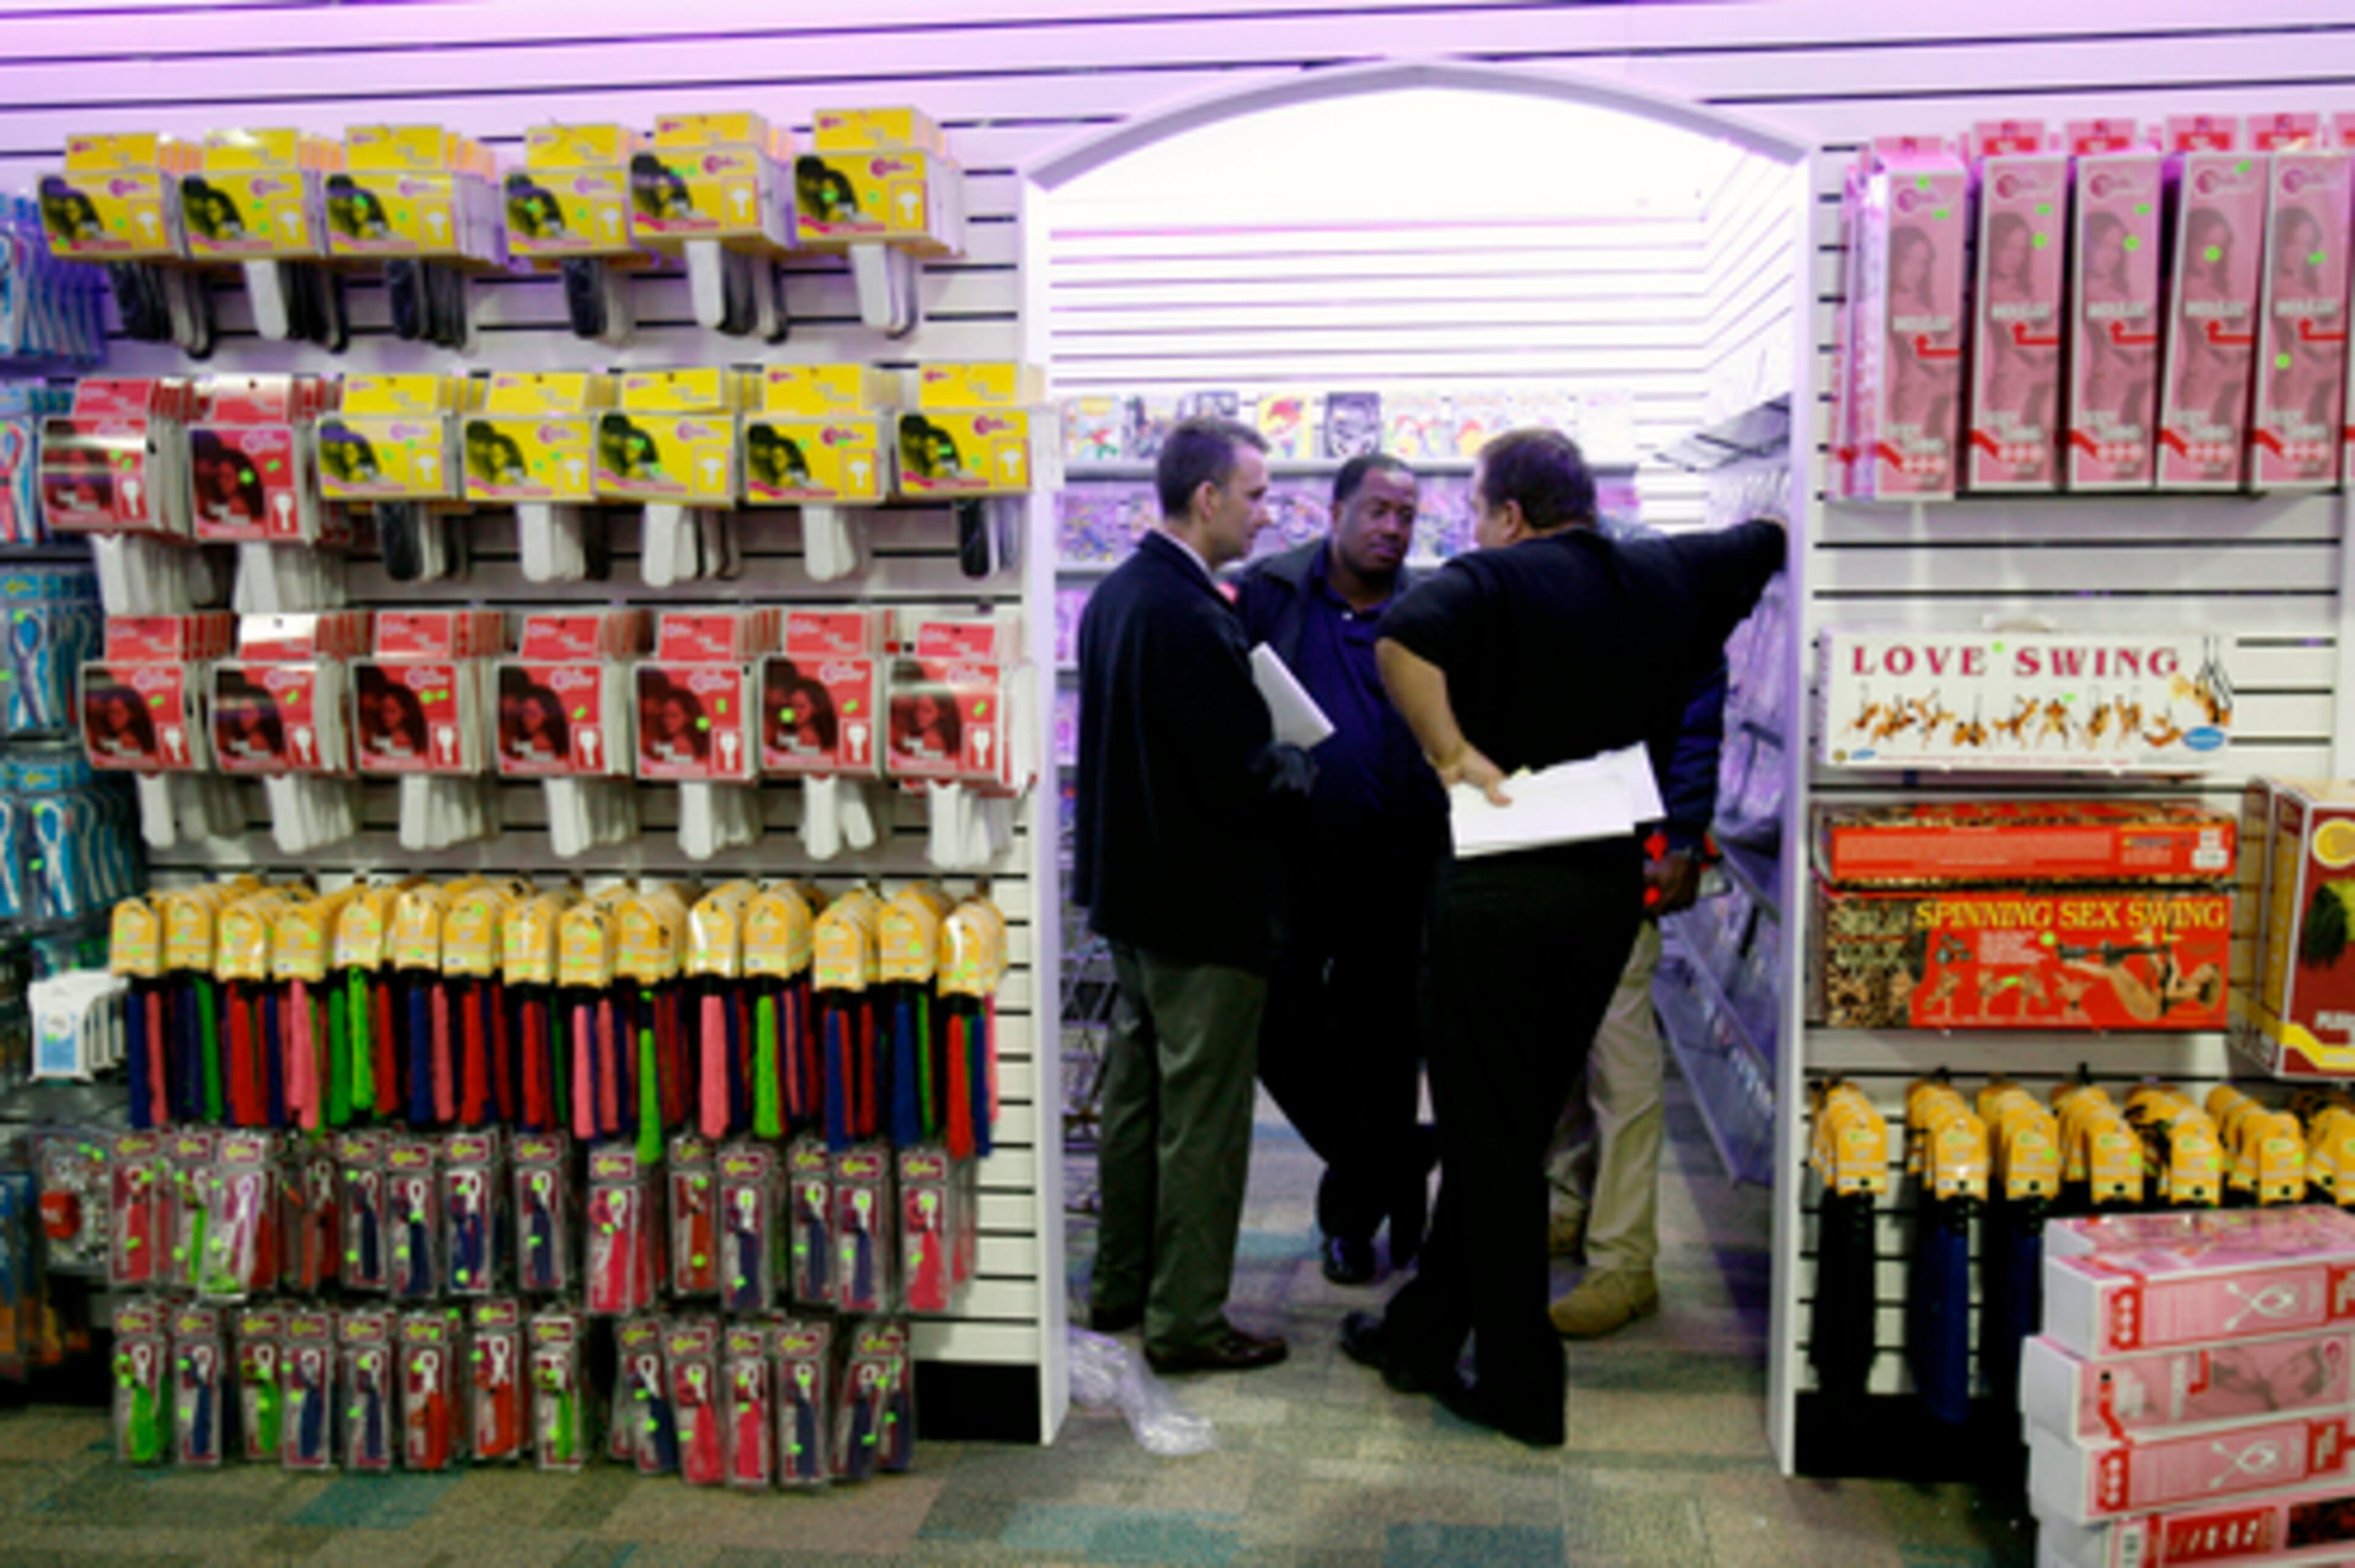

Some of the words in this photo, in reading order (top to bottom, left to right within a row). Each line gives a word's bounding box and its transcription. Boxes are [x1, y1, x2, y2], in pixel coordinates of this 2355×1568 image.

[1853, 644, 1986, 676] LOVE
[2014, 645, 2180, 676] SWING
[1915, 900, 2053, 929] SPINNING
[2059, 901, 2121, 929] SEX
[2127, 900, 2225, 929] SWING
